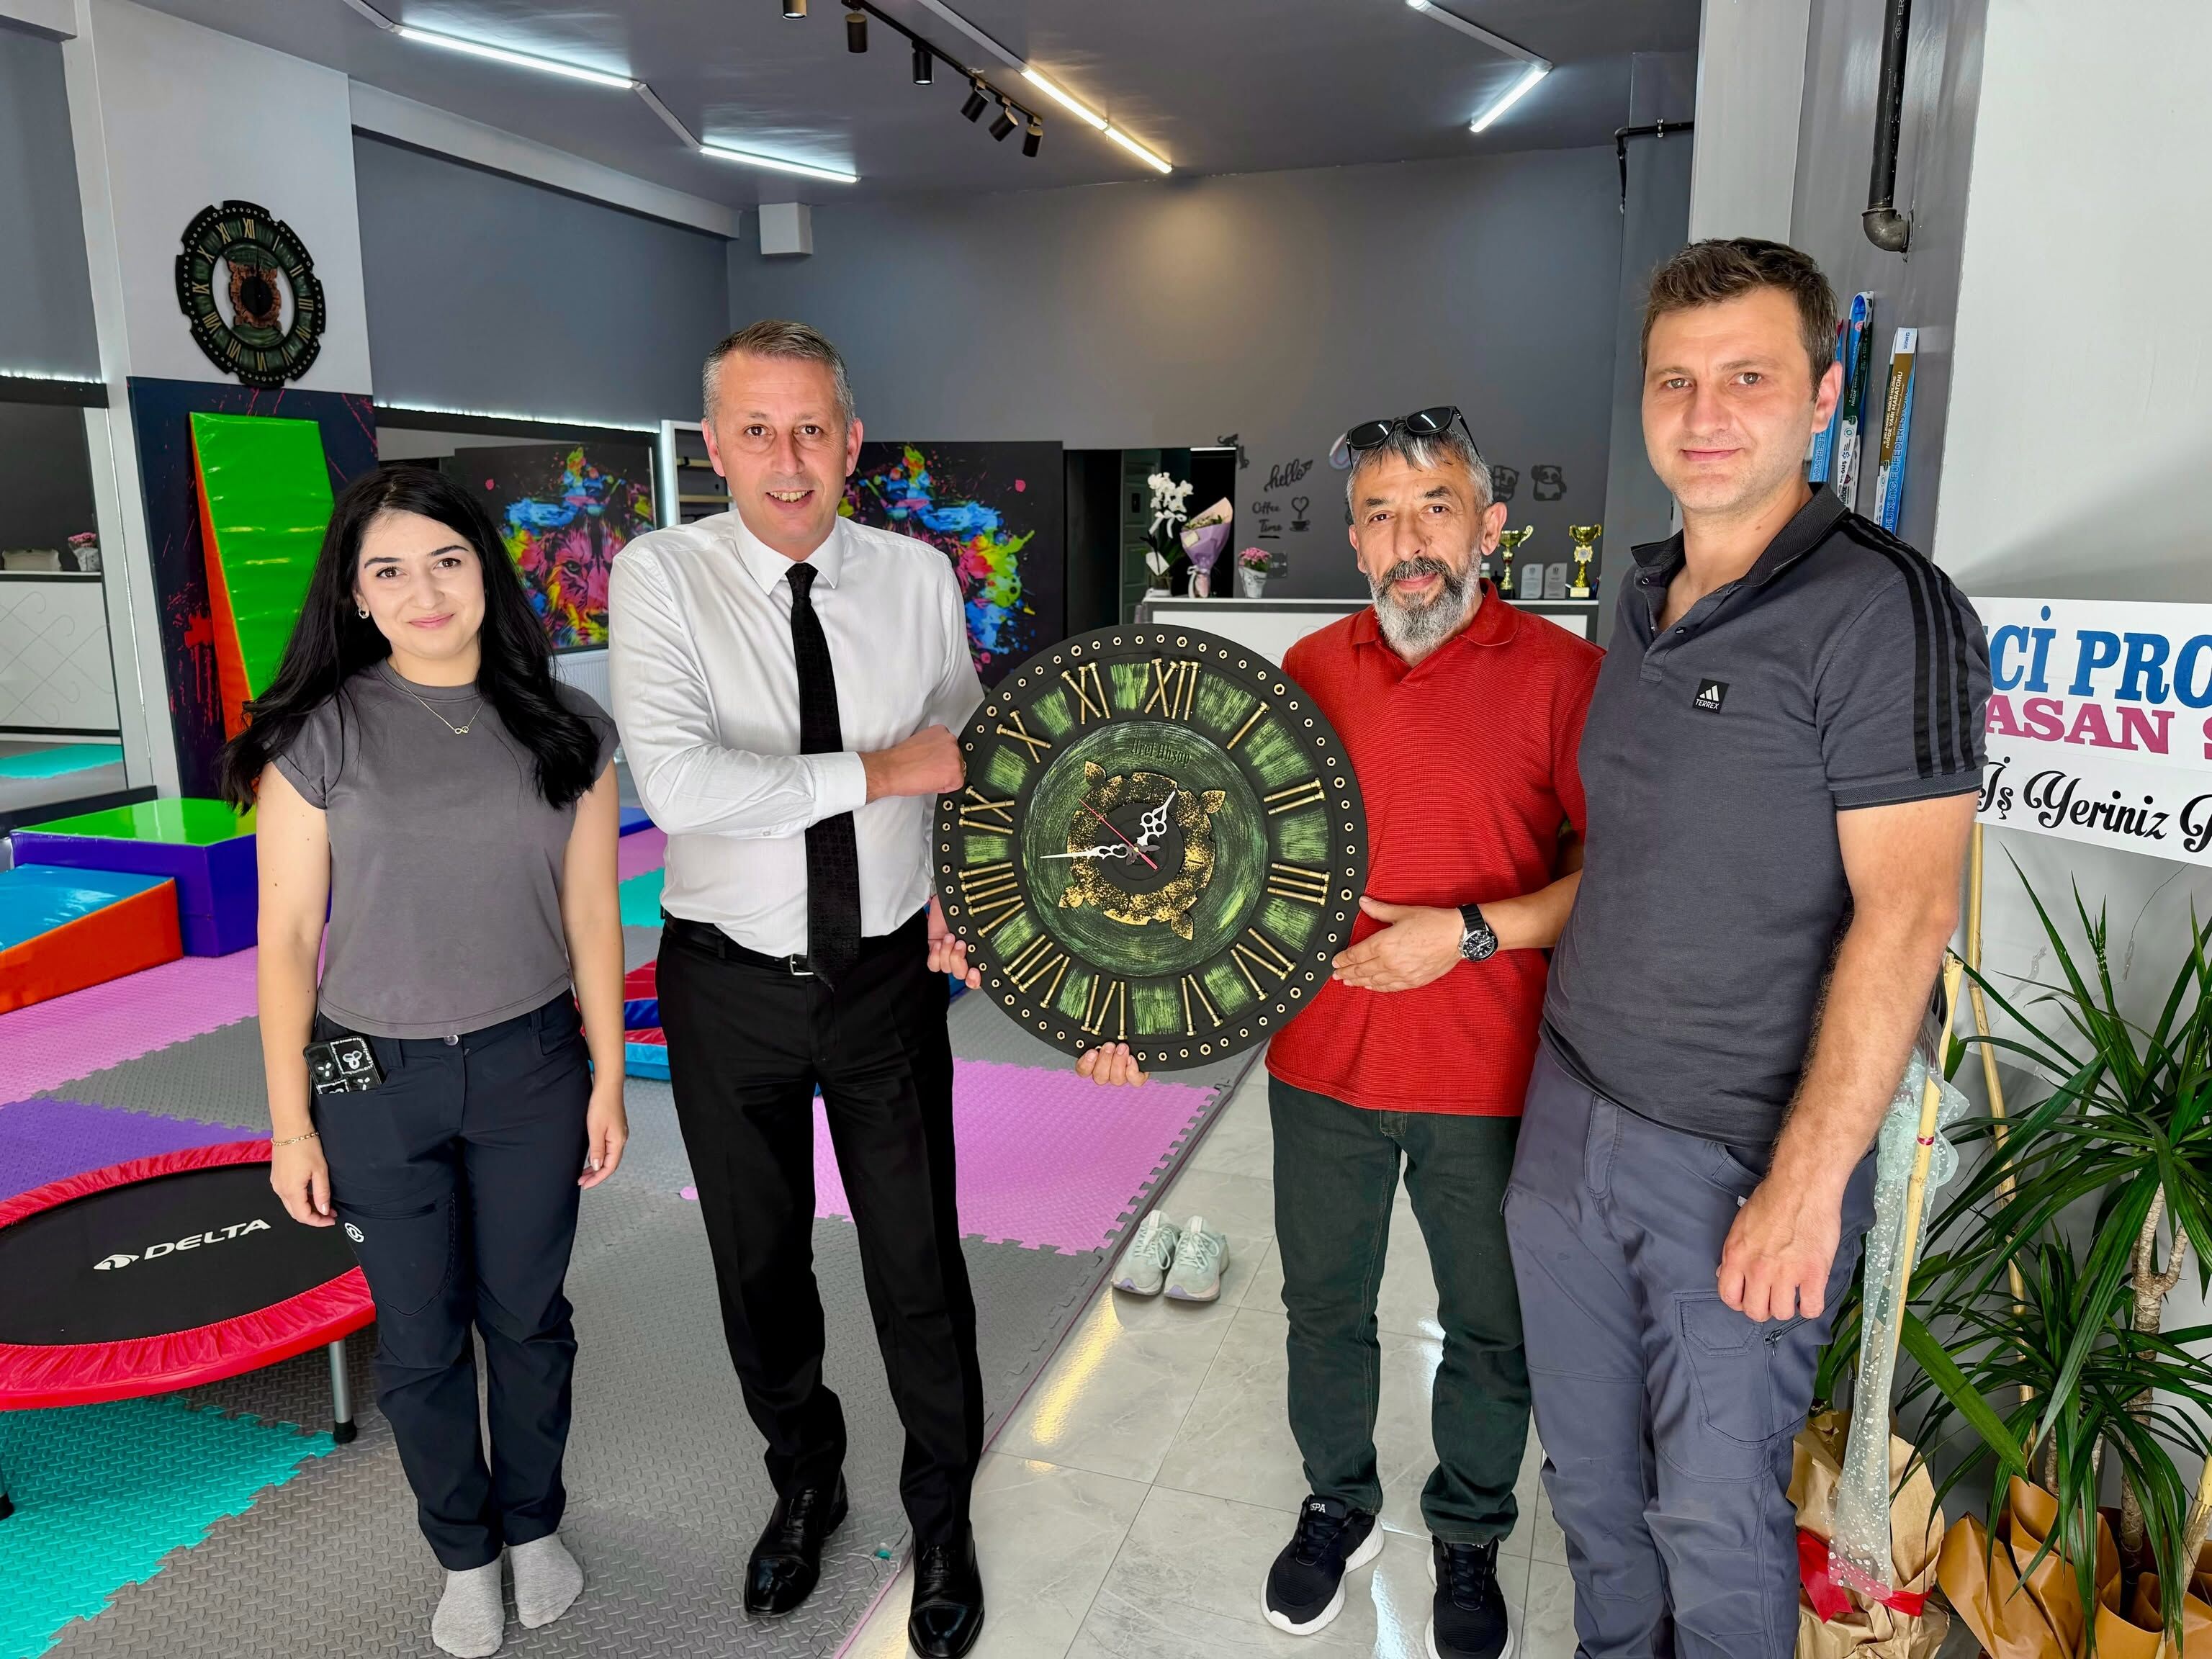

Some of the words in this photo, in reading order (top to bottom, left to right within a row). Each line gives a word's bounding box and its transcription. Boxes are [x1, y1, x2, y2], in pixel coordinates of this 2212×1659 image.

[1892, 371, 1903, 411] MARATONU
[1264, 458, 1310, 493] hello
[1890, 467, 1900, 480] FU
[1984, 605, 2056, 693] Cİ
[2068, 629, 2212, 709] PRO
[1695, 698, 1719, 710] TERREX
[2023, 770, 2170, 840] Yeriniz
[144, 1218, 271, 1260] DELTA
